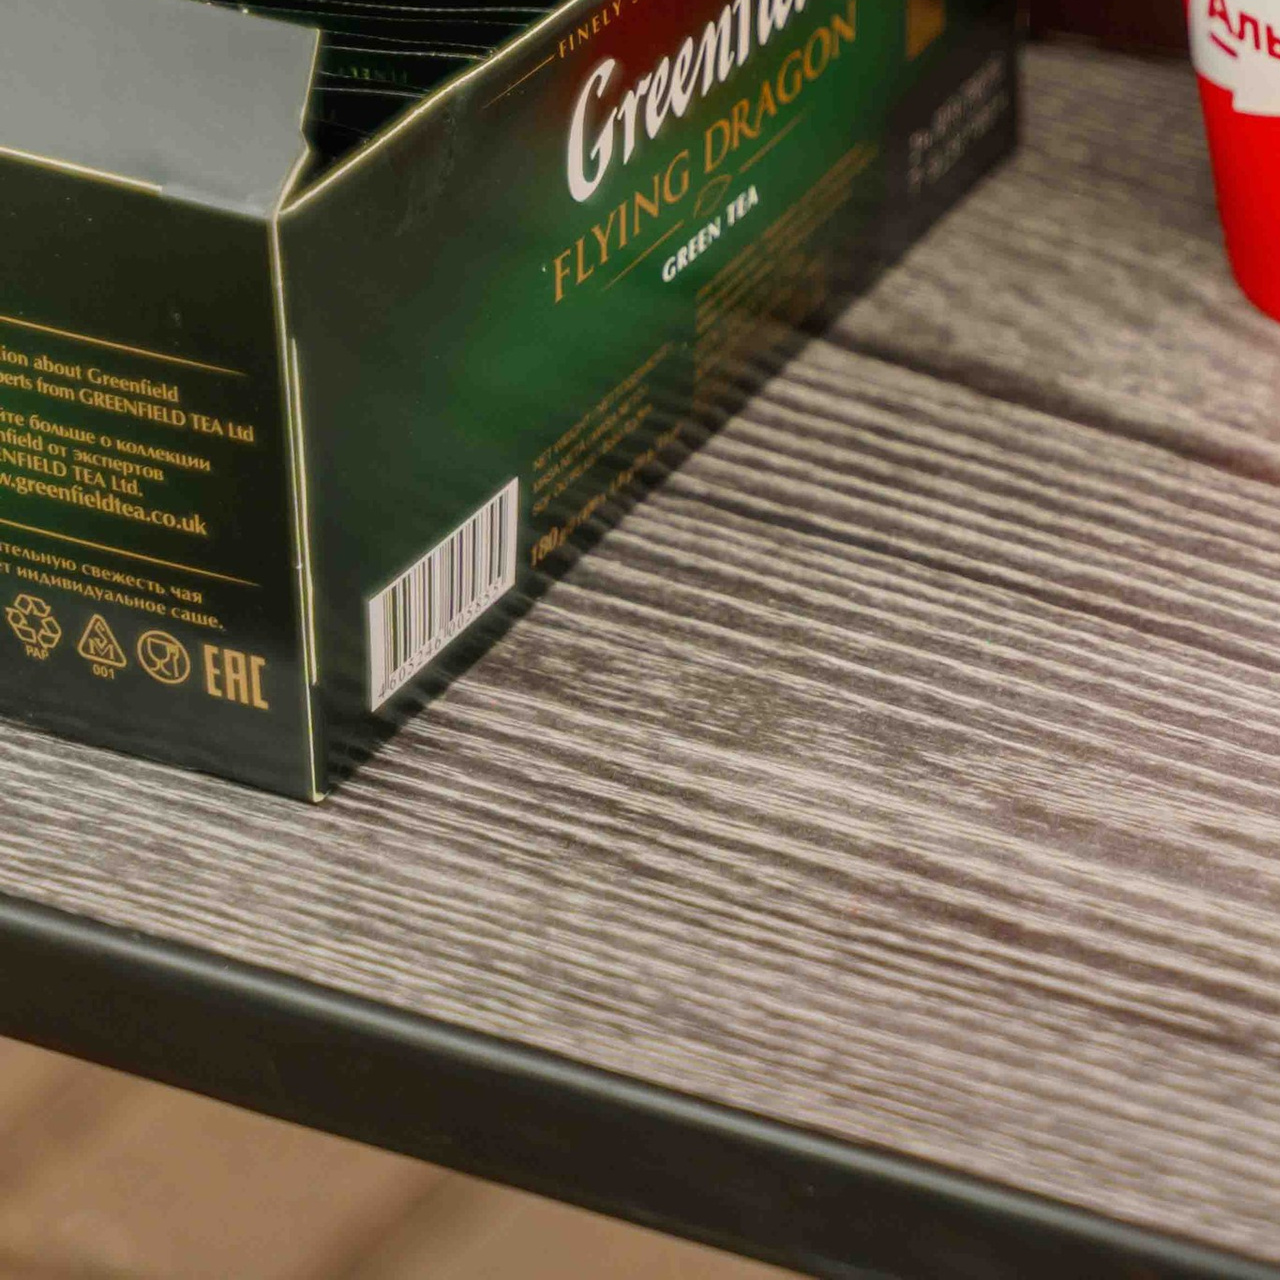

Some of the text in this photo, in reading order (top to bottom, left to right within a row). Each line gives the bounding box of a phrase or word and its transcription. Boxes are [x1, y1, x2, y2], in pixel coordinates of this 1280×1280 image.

[553, 148, 690, 304] FLYING
[661, 183, 759, 284] GREEN TEA
[33, 354, 82, 381] about
[87, 367, 179, 403] Greenfield
[37, 376, 76, 401] from
[79, 388, 187, 427] GREENFIELD
[188, 412, 224, 437] TEA
[228, 422, 255, 443] Ltd
[29, 414, 96, 445] больше
[100, 435, 113, 448] о
[116, 439, 211, 472] коллекции
[48, 442, 68, 458] от
[73, 448, 165, 482] экспертов
[72, 465, 107, 489] TEA
[111, 475, 143, 497] Ltd.
[16, 565, 167, 616] индивидуальное
[171, 606, 224, 630] саше.
[82, 563, 166, 595] свежесть
[170, 586, 203, 605] чая
[204, 643, 269, 711] EAC
